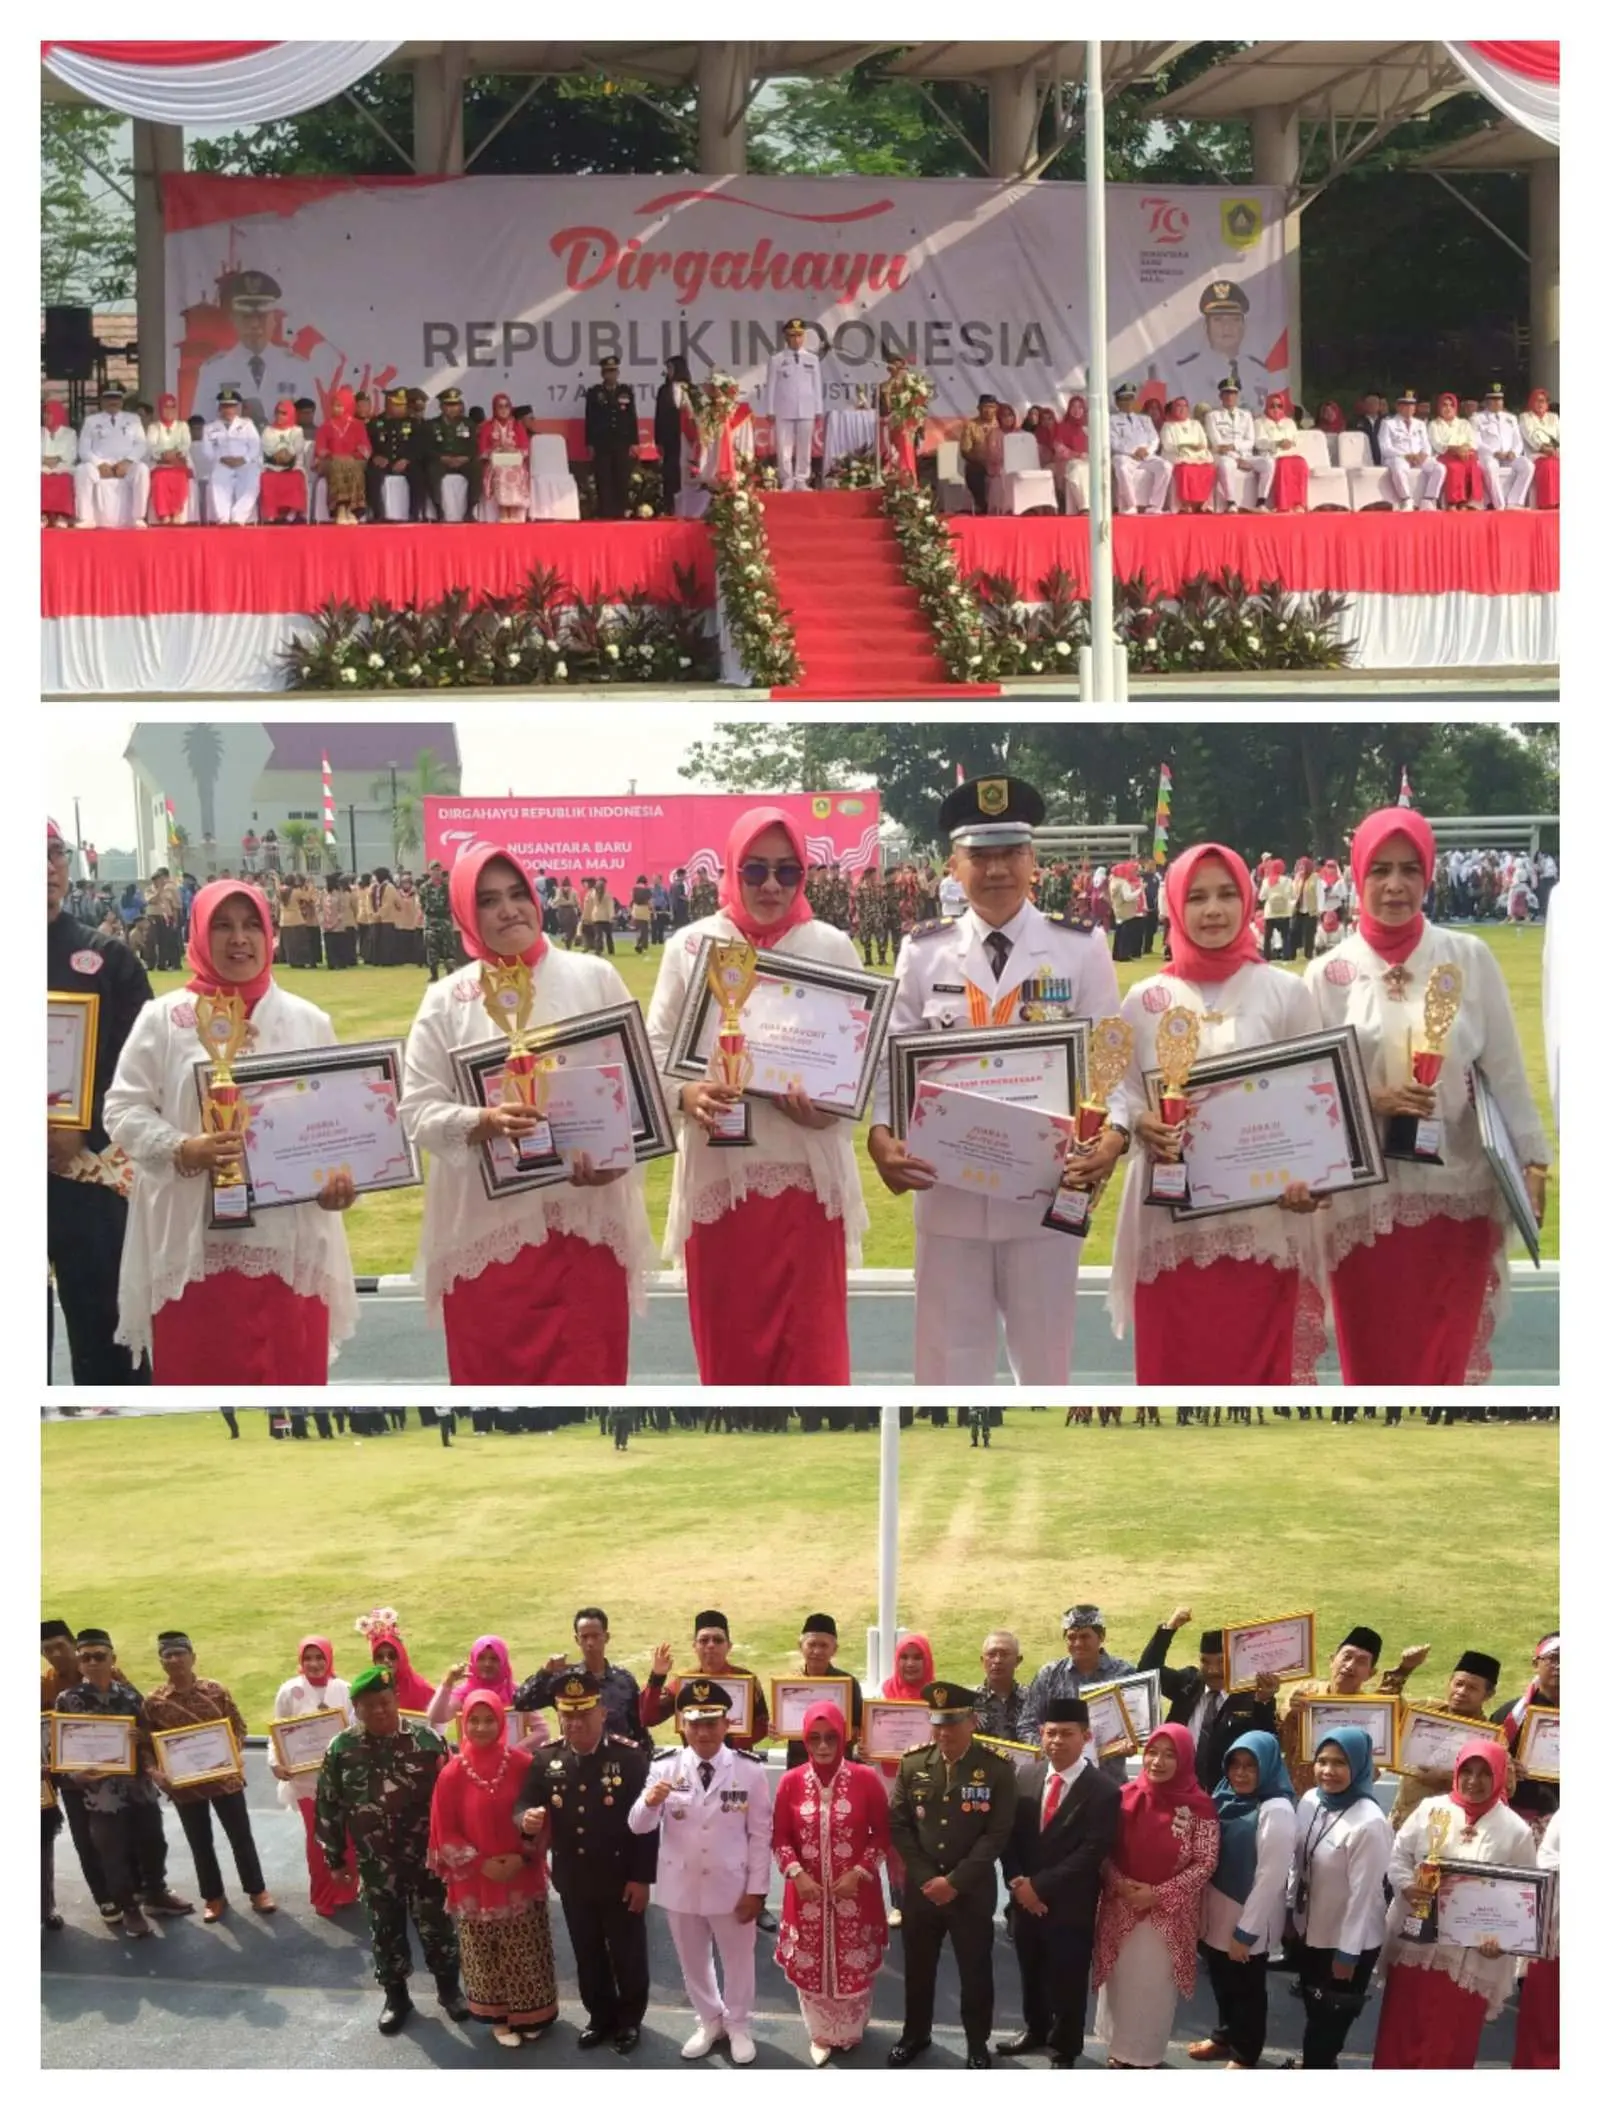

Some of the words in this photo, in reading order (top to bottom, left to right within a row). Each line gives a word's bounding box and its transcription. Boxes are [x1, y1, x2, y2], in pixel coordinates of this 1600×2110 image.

[549, 226, 913, 305] Dirgahayu
[422, 320, 716, 368] REPUBLIK
[547, 385, 568, 401] 17
[438, 807, 519, 820] DIRGAHAYU
[521, 806, 586, 819] REPUBLIK
[589, 805, 664, 818] INDONESIA
[507, 842, 592, 854] NUSANTARA
[595, 841, 632, 853] BARU
[522, 858, 582, 870] DONESIA
[586, 857, 625, 870] MAJU
